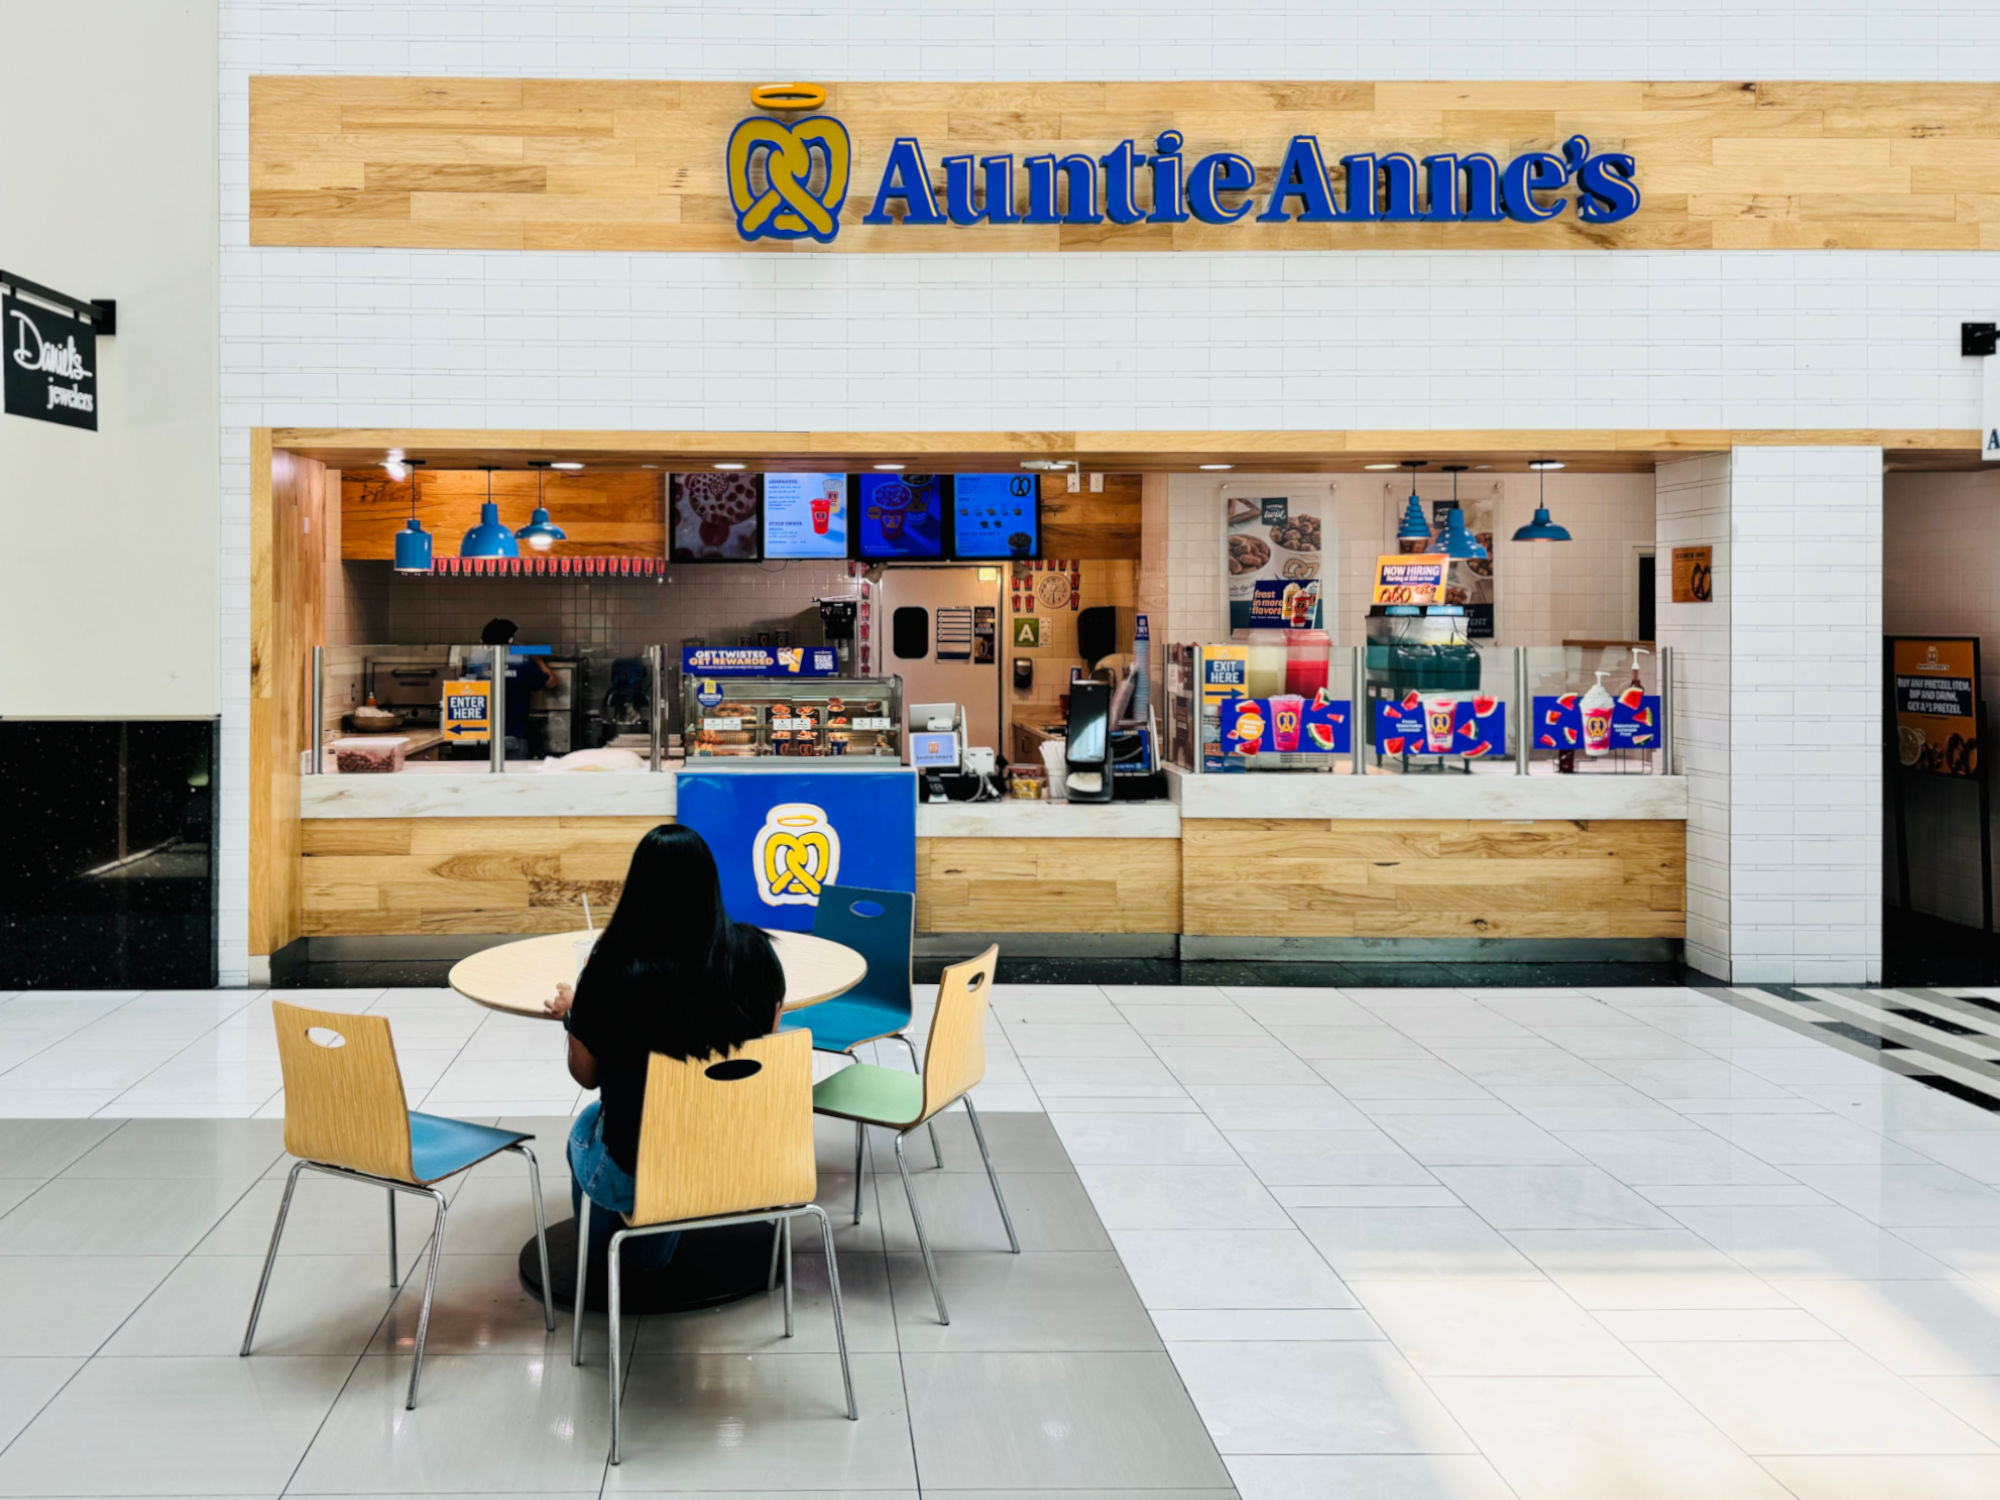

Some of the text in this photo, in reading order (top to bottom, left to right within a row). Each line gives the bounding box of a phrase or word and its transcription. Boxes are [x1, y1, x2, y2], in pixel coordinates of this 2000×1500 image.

[862, 129, 1641, 225] Auntie Anne's
[9, 309, 93, 380] Daniel's
[46, 376, 94, 412] jewelers
[1383, 565, 1440, 576] NOW HIRING
[1254, 590, 1276, 598] frost
[1251, 606, 1282, 615] flavors
[1018, 623, 1035, 642] A
[695, 650, 768, 658] GET TWISTED
[689, 657, 775, 666] GET REWARDED
[1213, 661, 1236, 672] EXIT
[1211, 673, 1239, 684] HERE
[1897, 677, 1910, 688] BUY
[1911, 678, 1923, 688] ANY
[1924, 679, 1952, 690] PRETZEL
[1909, 689, 1921, 699] DIP
[1921, 690, 1935, 700] AND
[450, 696, 485, 708] ENTER
[1907, 701, 1921, 712] GET
[1921, 702, 1926, 712] A
[453, 708, 482, 719] HERE
